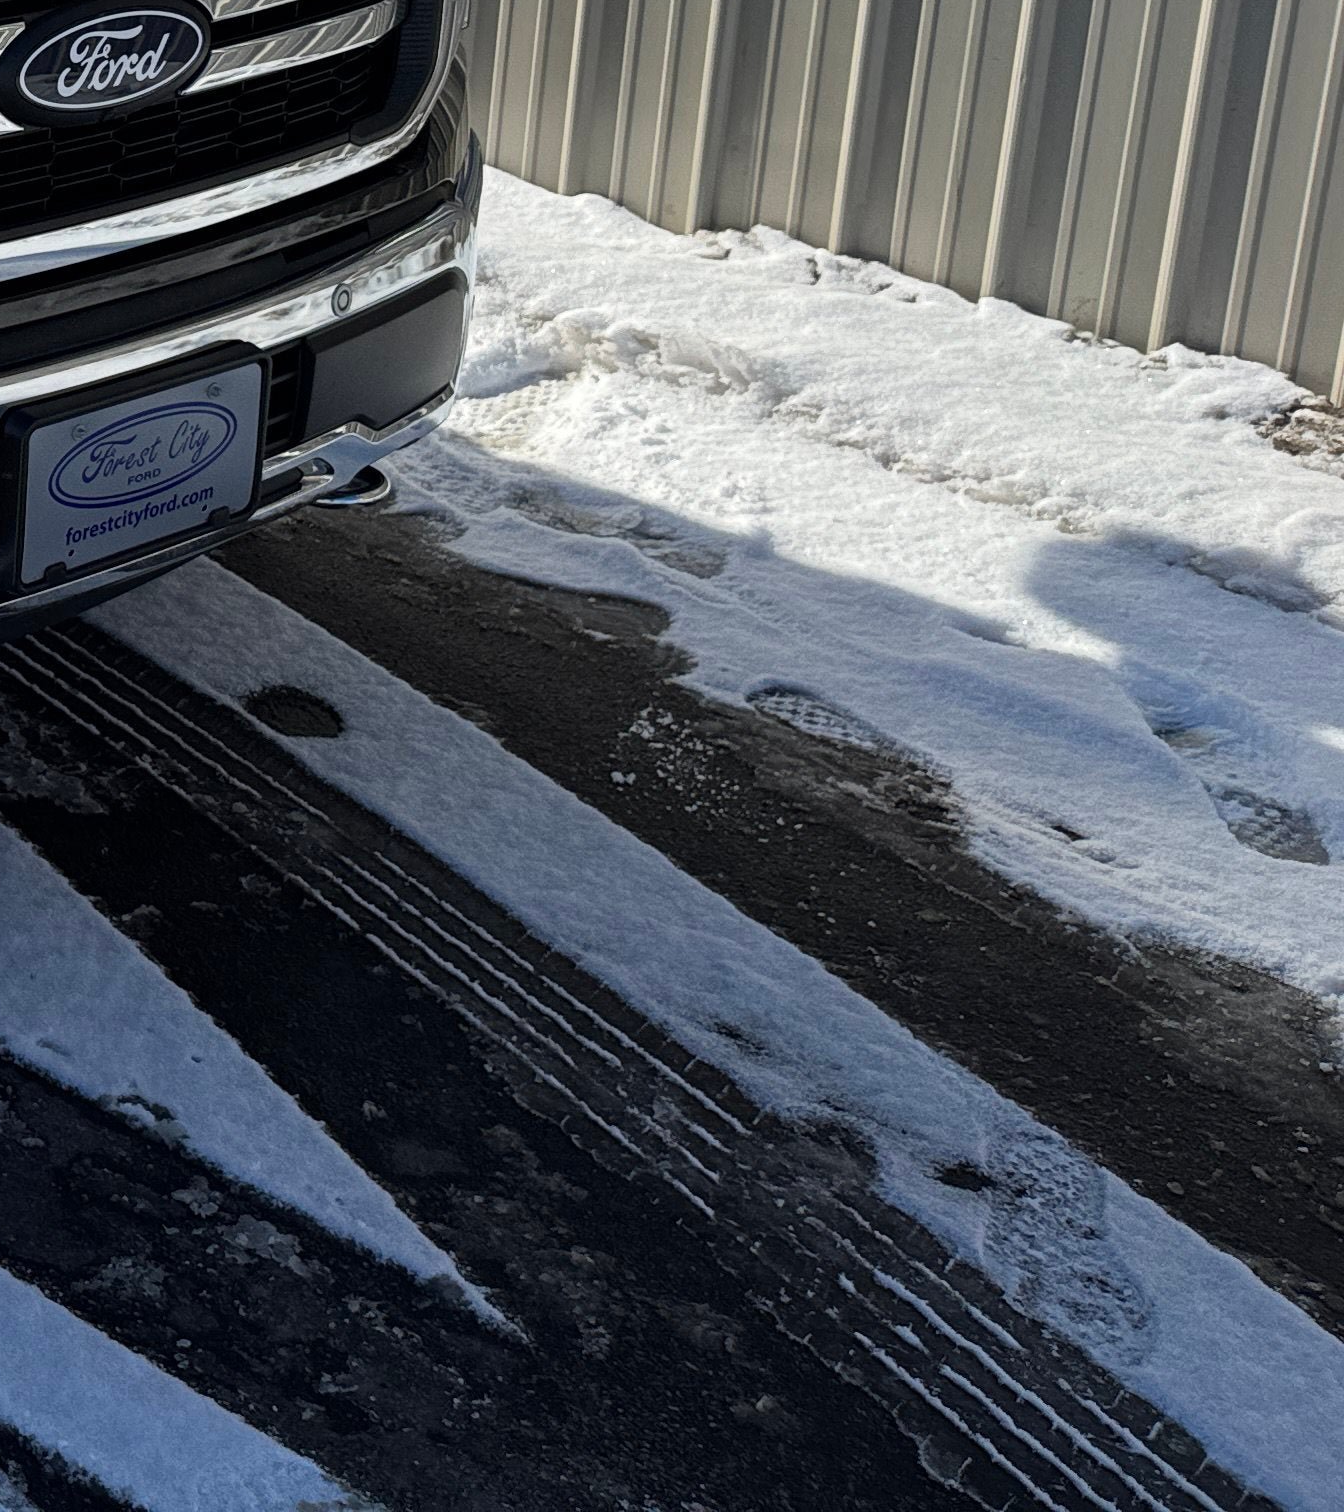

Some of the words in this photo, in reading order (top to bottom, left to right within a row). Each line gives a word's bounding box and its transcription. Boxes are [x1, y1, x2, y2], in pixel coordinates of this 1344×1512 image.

[57, 24, 171, 98] Ford
[81, 434, 161, 484] Forest
[168, 419, 211, 464] City
[126, 467, 162, 486] FORD
[64, 486, 214, 546] forestcityford.com
